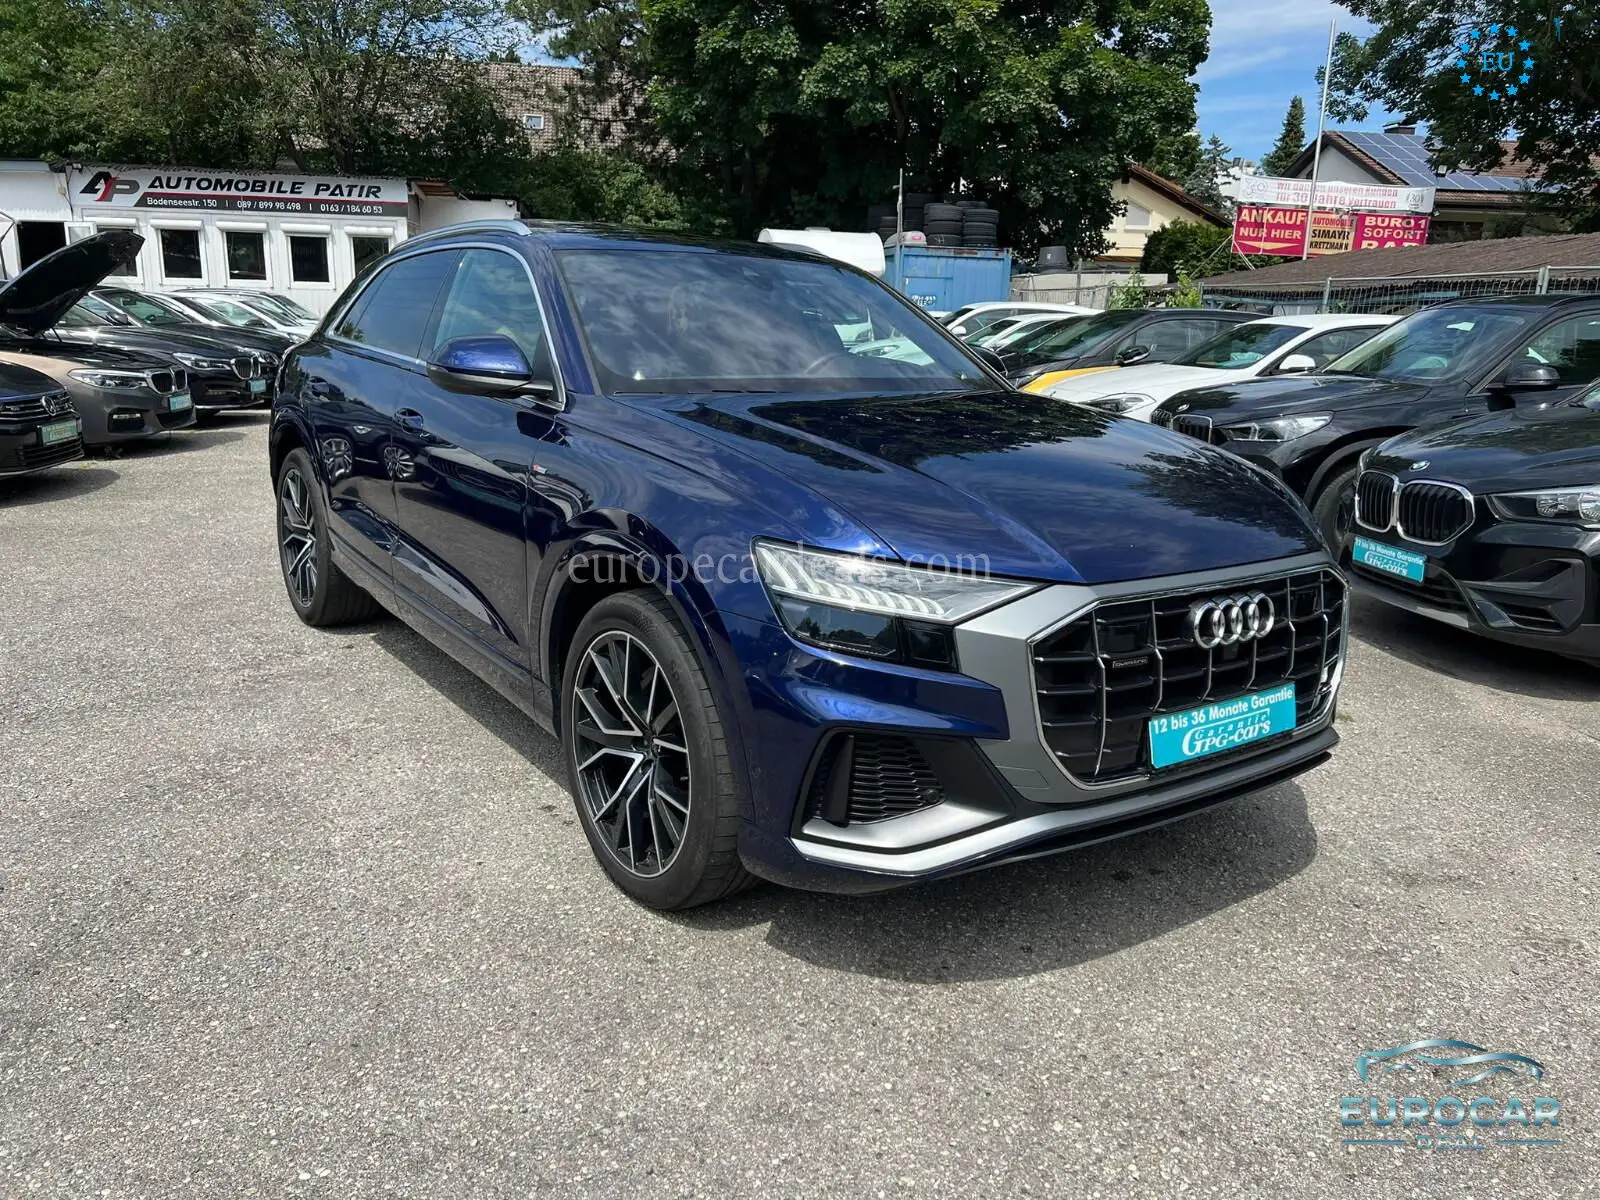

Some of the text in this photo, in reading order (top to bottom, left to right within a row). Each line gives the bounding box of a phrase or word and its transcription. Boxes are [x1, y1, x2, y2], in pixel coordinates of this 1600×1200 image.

[148, 176, 382, 199] AUTOMOBILE PATIR
[147, 197, 201, 207] Bodenseestr.
[203, 199, 217, 208] 150
[236, 200, 252, 209] 089
[258, 201, 273, 209] 899
[275, 202, 285, 210] 98
[286, 202, 301, 210] 498
[320, 204, 339, 212] 0163
[346, 205, 361, 213] 184
[362, 205, 372, 213] 60
[373, 206, 383, 214] 53
[1238, 208, 1307, 226] ANKAUF
[1239, 227, 1302, 239] NUR HIER
[1362, 227, 1424, 240] SOFORT
[1153, 687, 1293, 734] 12 bis 36 Monate Garantie
